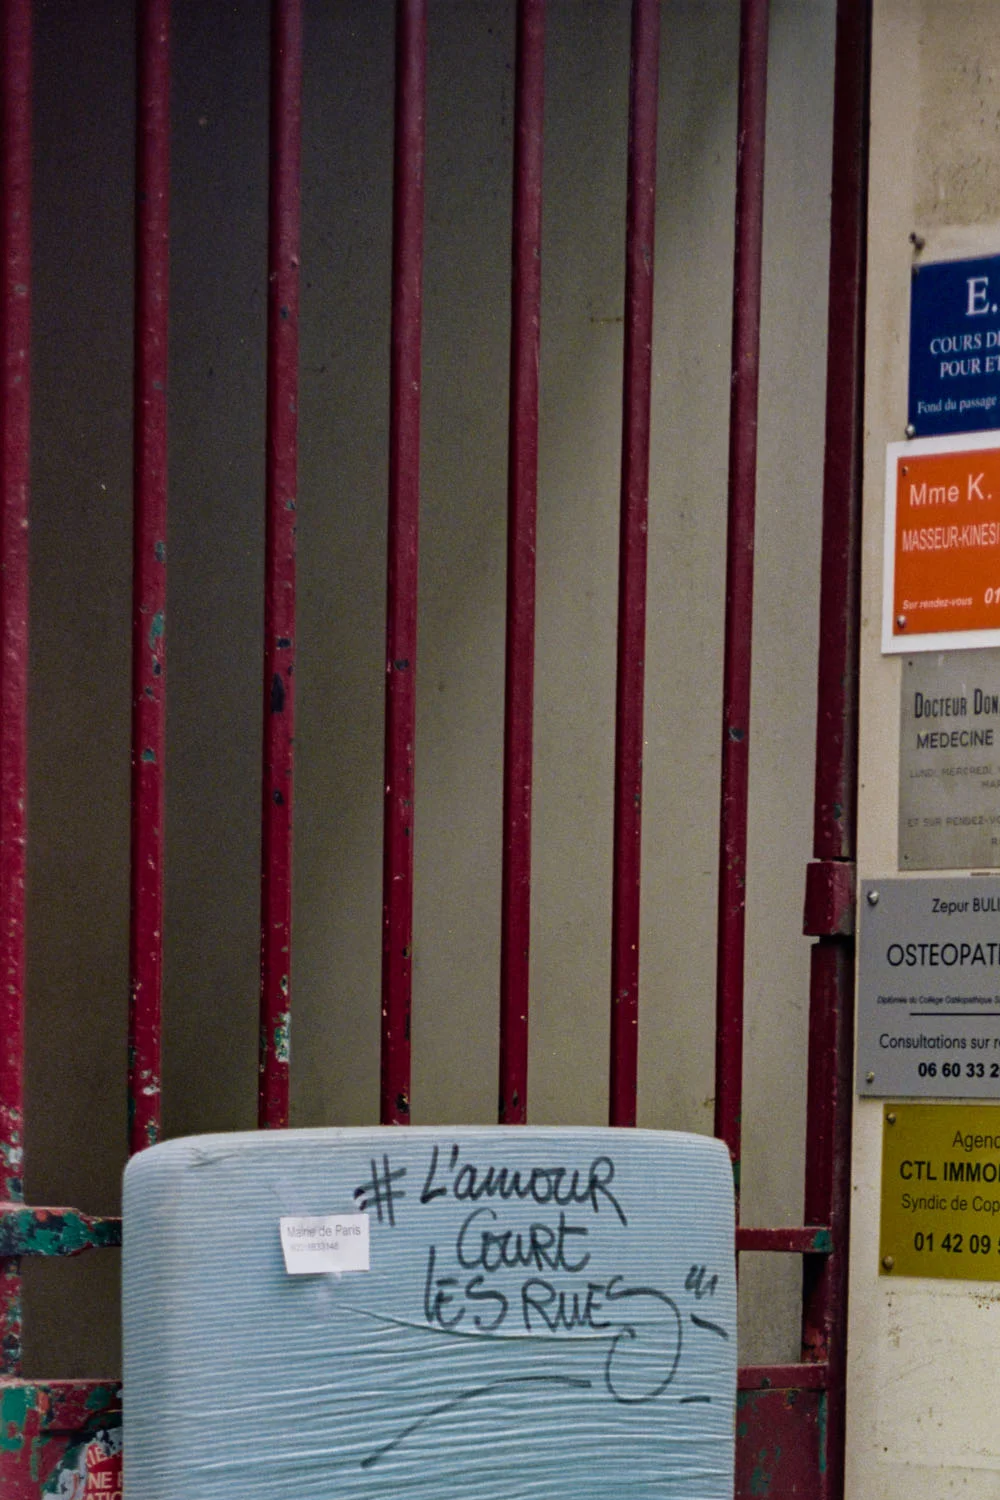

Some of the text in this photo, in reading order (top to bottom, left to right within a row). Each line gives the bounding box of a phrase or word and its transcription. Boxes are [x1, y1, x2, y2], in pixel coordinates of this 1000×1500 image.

[930, 331, 982, 355] COURS
[939, 357, 982, 378] POUR
[917, 399, 942, 414] Fond
[944, 398, 957, 411] du
[959, 396, 997, 412] passage
[909, 483, 960, 506] Mme
[967, 472, 993, 500] K.
[903, 599, 918, 610] Sur
[919, 596, 973, 609] rendez-vous
[916, 729, 994, 749] MEDECINE
[932, 898, 969, 915] Zepur
[879, 1033, 967, 1049] Consultations
[971, 1036, 989, 1049] sur
[918, 1063, 937, 1078] 06
[942, 1063, 961, 1078] 60
[966, 1063, 985, 1078] 33
[900, 1160, 937, 1181] CTL
[901, 1194, 947, 1214] Syndic
[950, 1196, 968, 1211] de
[319, 1225, 332, 1237] de
[335, 1224, 361, 1237] Paris
[914, 1232, 934, 1251] 01
[941, 1234, 963, 1253] 42
[969, 1235, 991, 1254] 09
